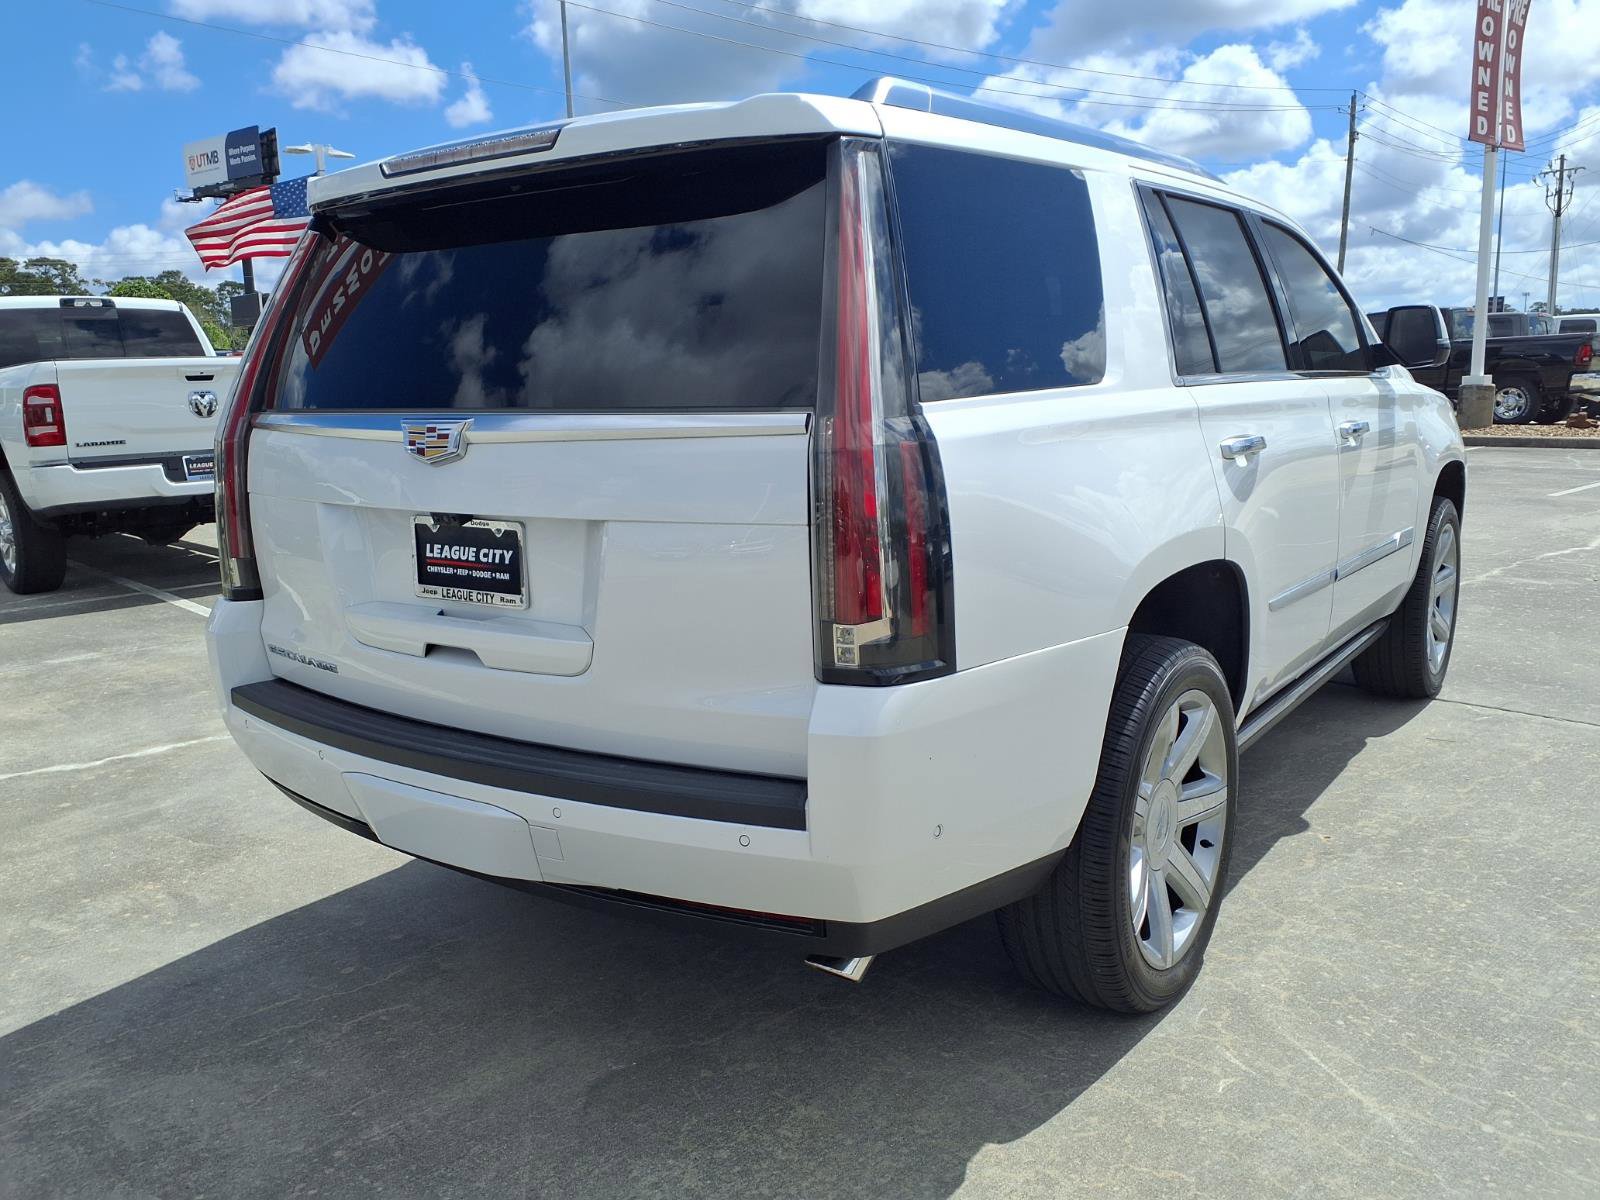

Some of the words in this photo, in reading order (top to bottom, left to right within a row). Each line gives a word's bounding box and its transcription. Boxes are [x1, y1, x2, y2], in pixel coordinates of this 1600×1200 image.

[1477, 16, 1495, 136] OWNED
[1505, 29, 1516, 143] OWNED
[196, 150, 219, 167] UTMB
[75, 439, 126, 448] LARAMIE
[470, 519, 490, 527] Dodge
[425, 543, 477, 561] LEAGUE
[479, 547, 513, 564] CITY
[426, 565, 454, 574] CHRYSLER
[456, 568, 469, 576] JEEP
[472, 570, 492, 579] DODGE
[495, 572, 510, 580] RAM
[421, 587, 438, 595] Jeep
[441, 588, 474, 601] LEAGUE
[475, 591, 495, 604] CITY
[500, 596, 517, 605] Ram
